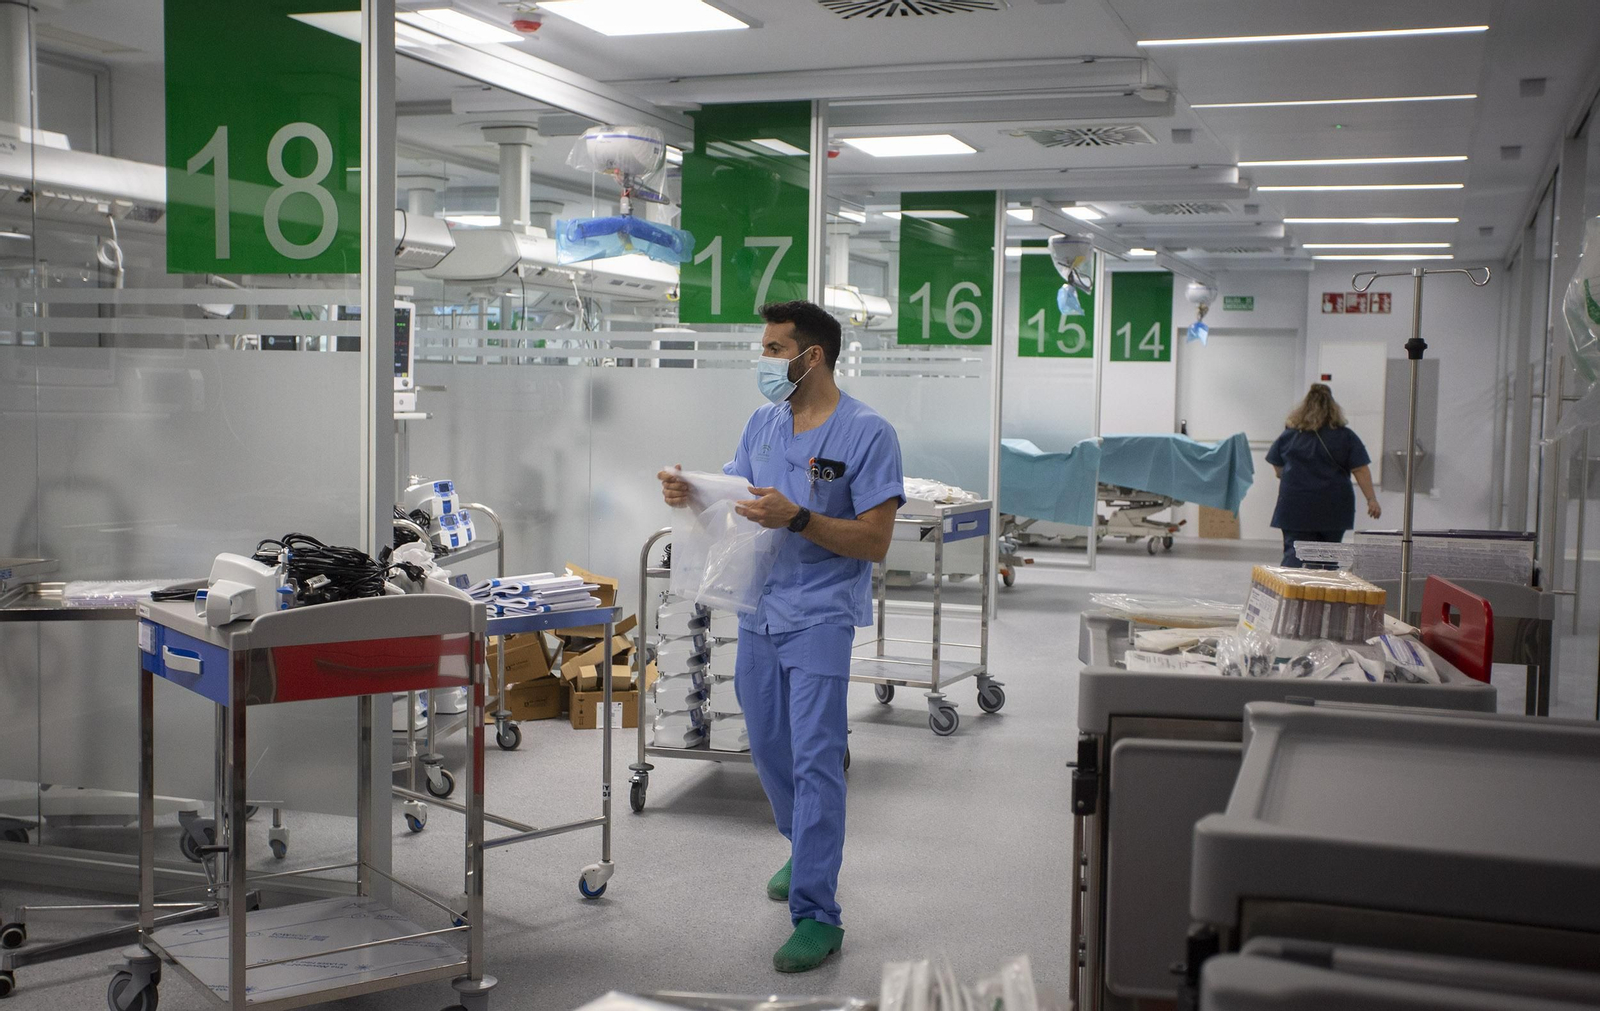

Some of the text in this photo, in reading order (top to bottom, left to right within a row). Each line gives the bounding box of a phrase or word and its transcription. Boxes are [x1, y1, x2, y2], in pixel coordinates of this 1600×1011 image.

[185, 121, 339, 261] 18
[693, 235, 793, 316] 17
[908, 281, 984, 341] 16
[1027, 308, 1087, 354] 15
[1116, 321, 1165, 359] 14
